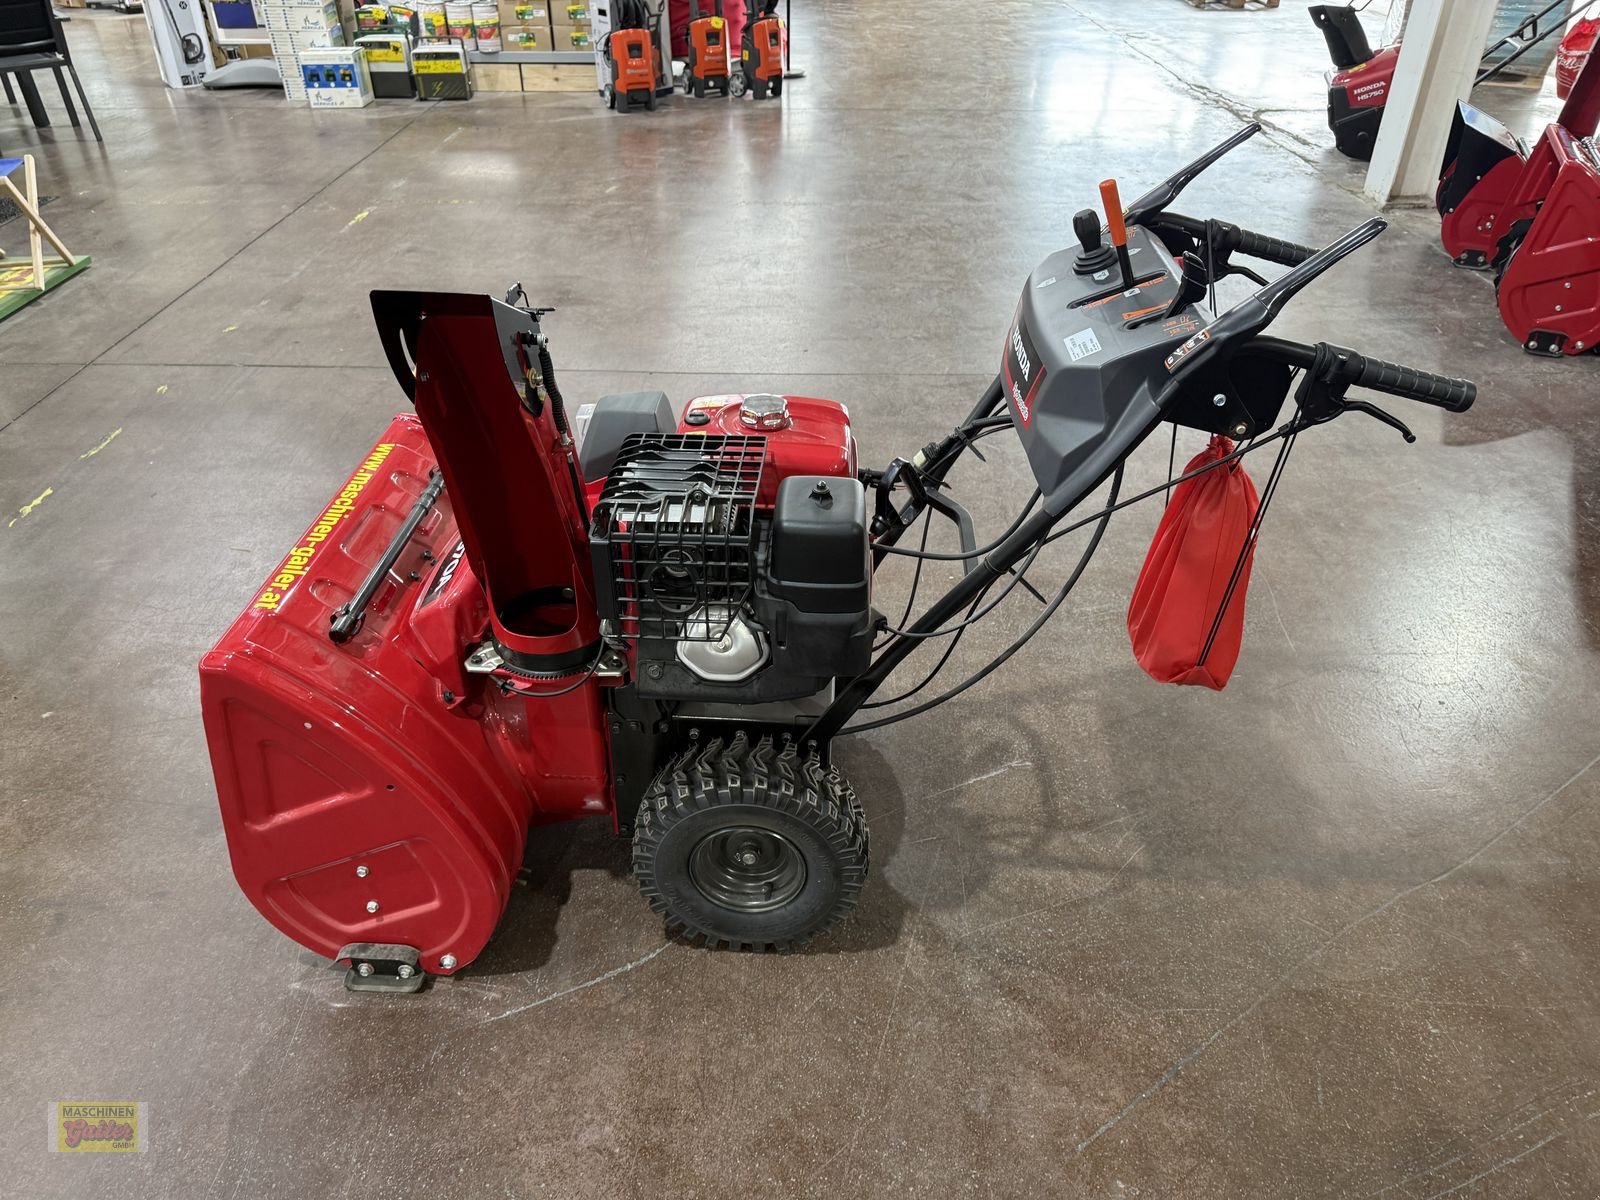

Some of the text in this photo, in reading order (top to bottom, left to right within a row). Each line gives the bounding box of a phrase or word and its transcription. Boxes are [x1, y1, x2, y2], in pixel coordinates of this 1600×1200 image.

[1353, 80, 1387, 95] HONDA
[1357, 89, 1384, 102] HS750
[1012, 325, 1031, 382] HONDA
[254, 443, 396, 610] www.maschinen-gailer.at
